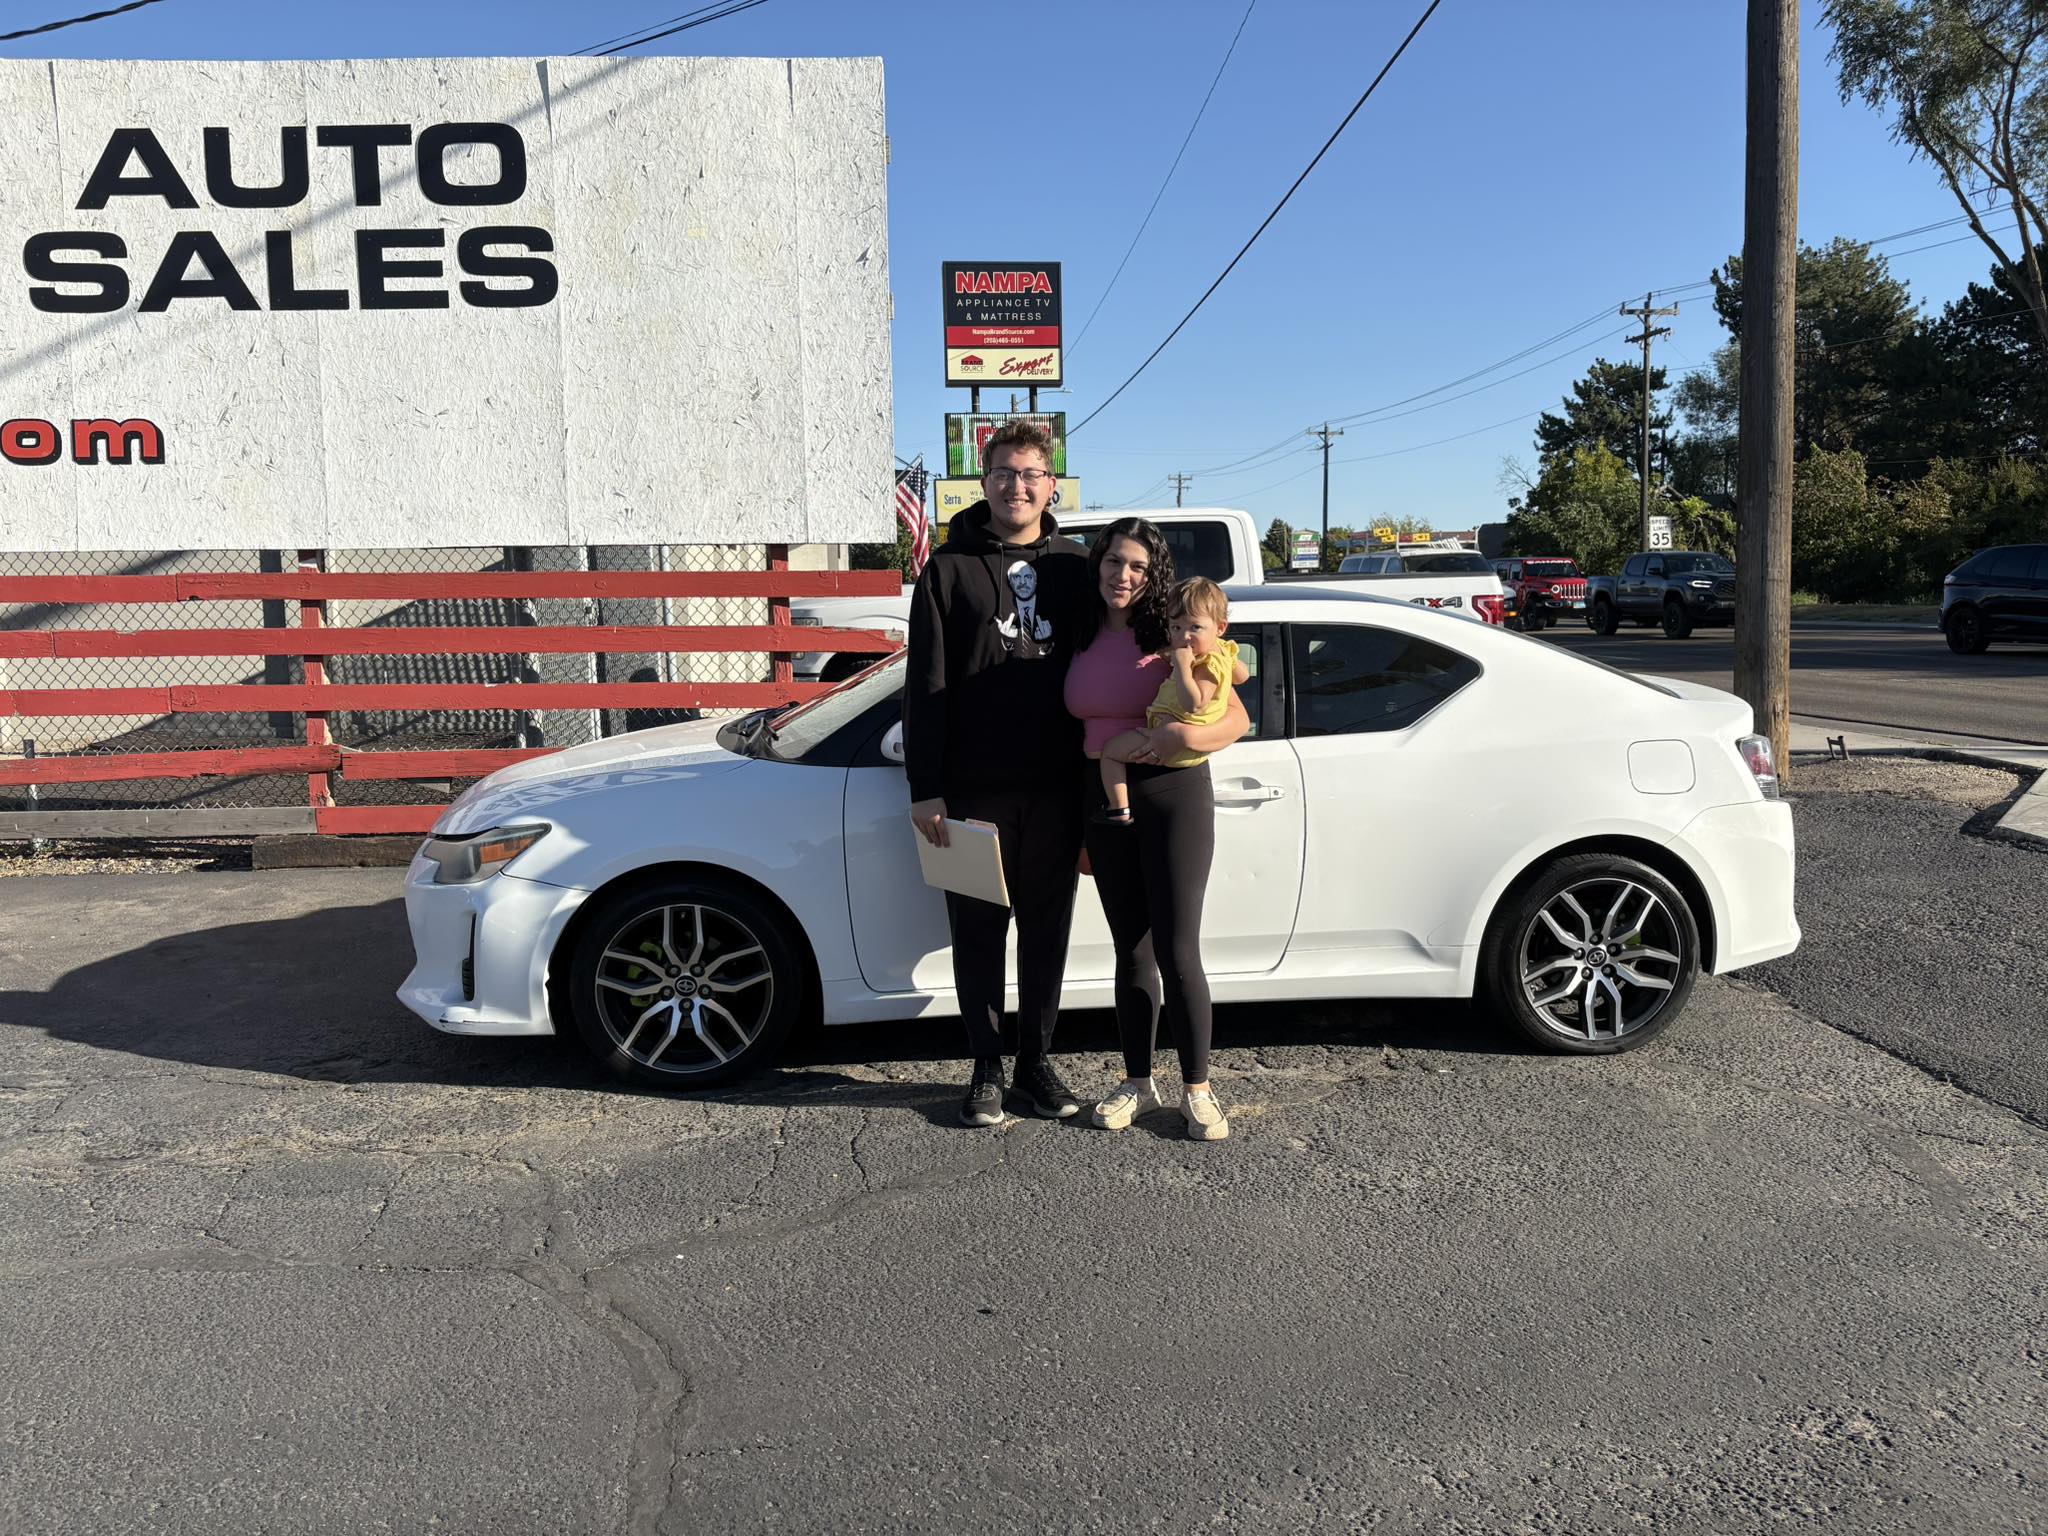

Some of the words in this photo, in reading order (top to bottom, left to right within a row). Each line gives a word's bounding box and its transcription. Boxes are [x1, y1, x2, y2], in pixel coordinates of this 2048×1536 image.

[75, 122, 527, 210] AUTO
[23, 226, 559, 313] SALES
[955, 271, 1053, 294] NAMPA
[956, 299, 1031, 307] APPLIANCE
[1035, 299, 1051, 307] TV
[965, 312, 972, 321] &
[980, 312, 1042, 321] MATTRESS
[999, 352, 1054, 377] Expert
[1026, 368, 1054, 376] DELIVERY
[943, 494, 962, 505] Serta
[1652, 532, 1670, 546] 35
